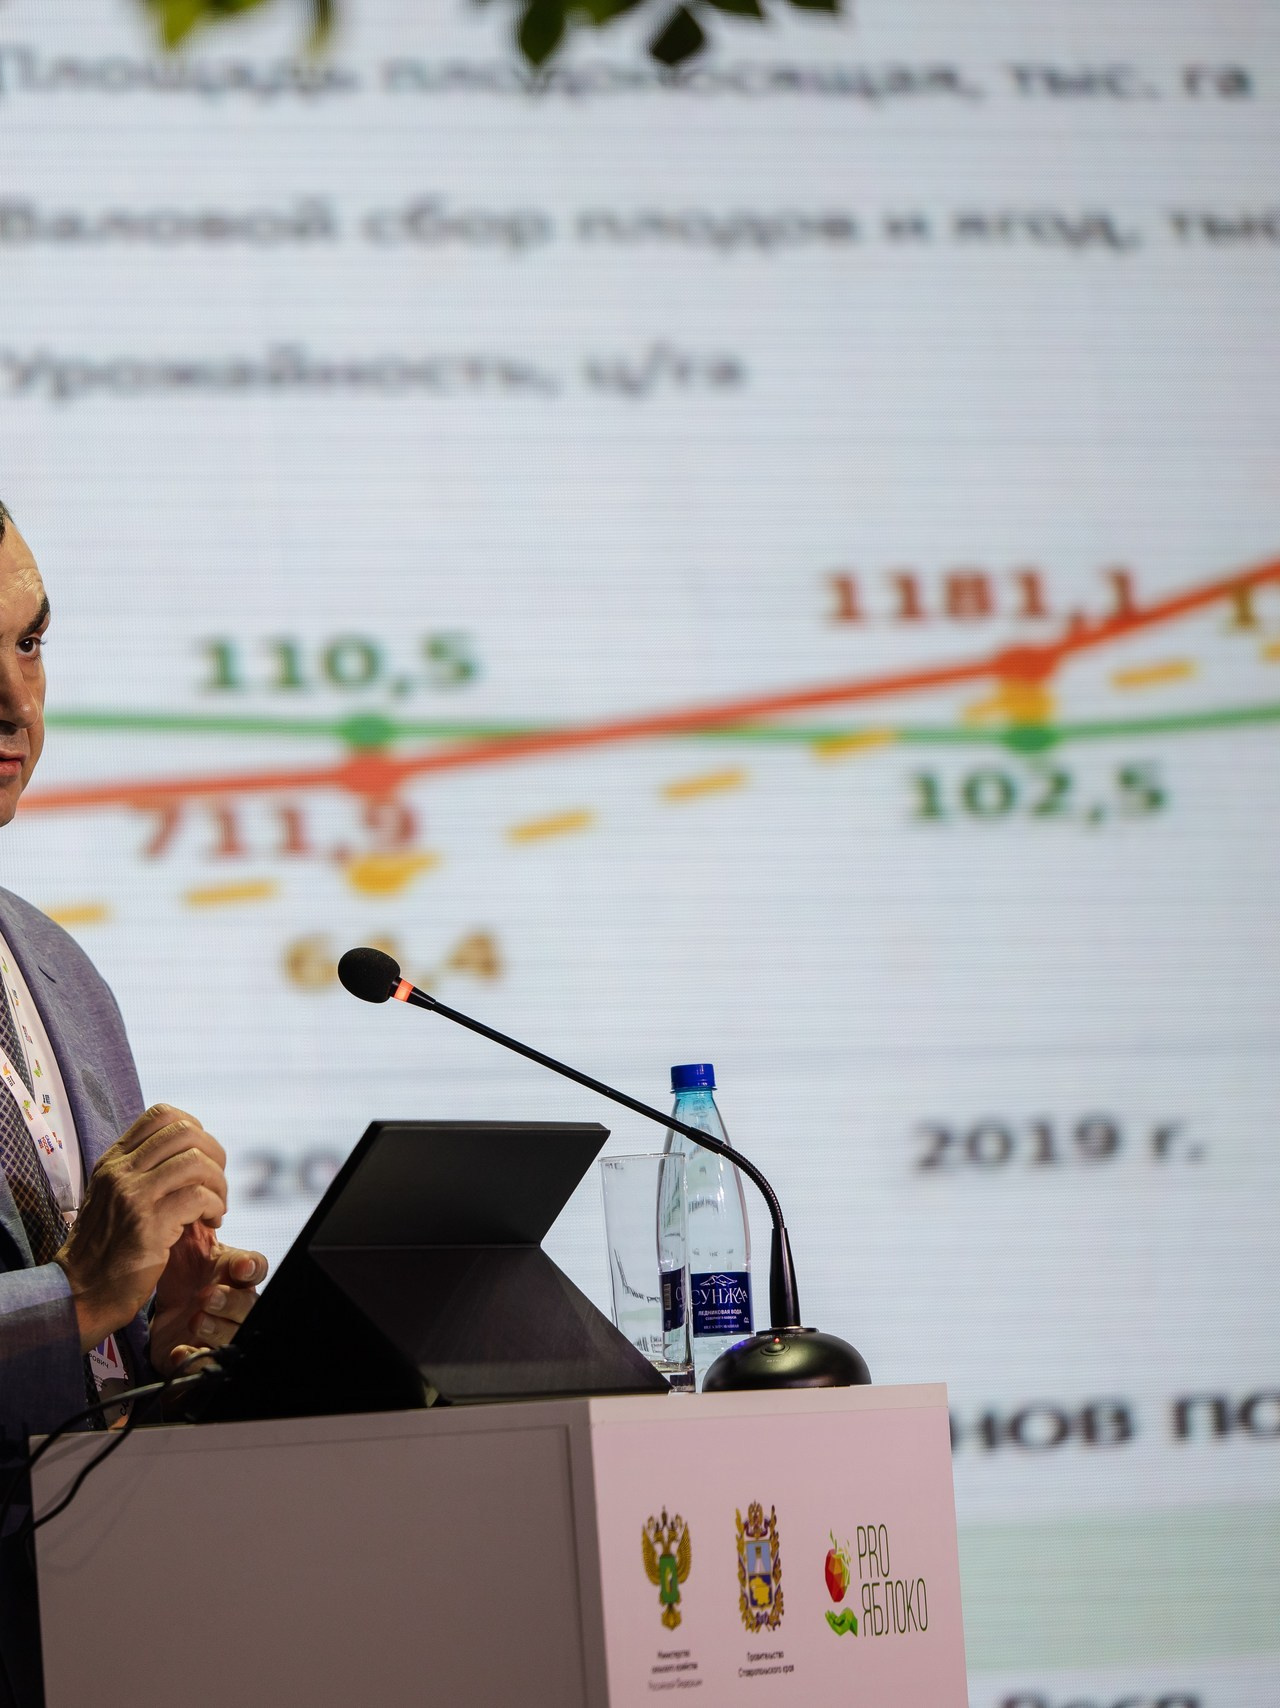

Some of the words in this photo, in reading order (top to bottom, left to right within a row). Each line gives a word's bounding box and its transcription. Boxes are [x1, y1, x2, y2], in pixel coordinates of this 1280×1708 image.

[1180, 60, 1252, 100] га
[360, 190, 556, 256] сбор
[575, 206, 860, 258] плодов
[882, 208, 928, 248] и
[952, 208, 1140, 258] ягод,
[582, 334, 746, 404] ц/га
[192, 630, 484, 700] 110,5
[910, 756, 1172, 828] 102,5
[140, 796, 422, 866] 711,9
[282, 930, 502, 996] 6,4
[914, 1110, 1124, 1172] 2019
[1144, 1116, 1208, 1166] г.
[857, 1524, 890, 1579] PRO
[861, 1578, 928, 1637] ЯБЛОКО
